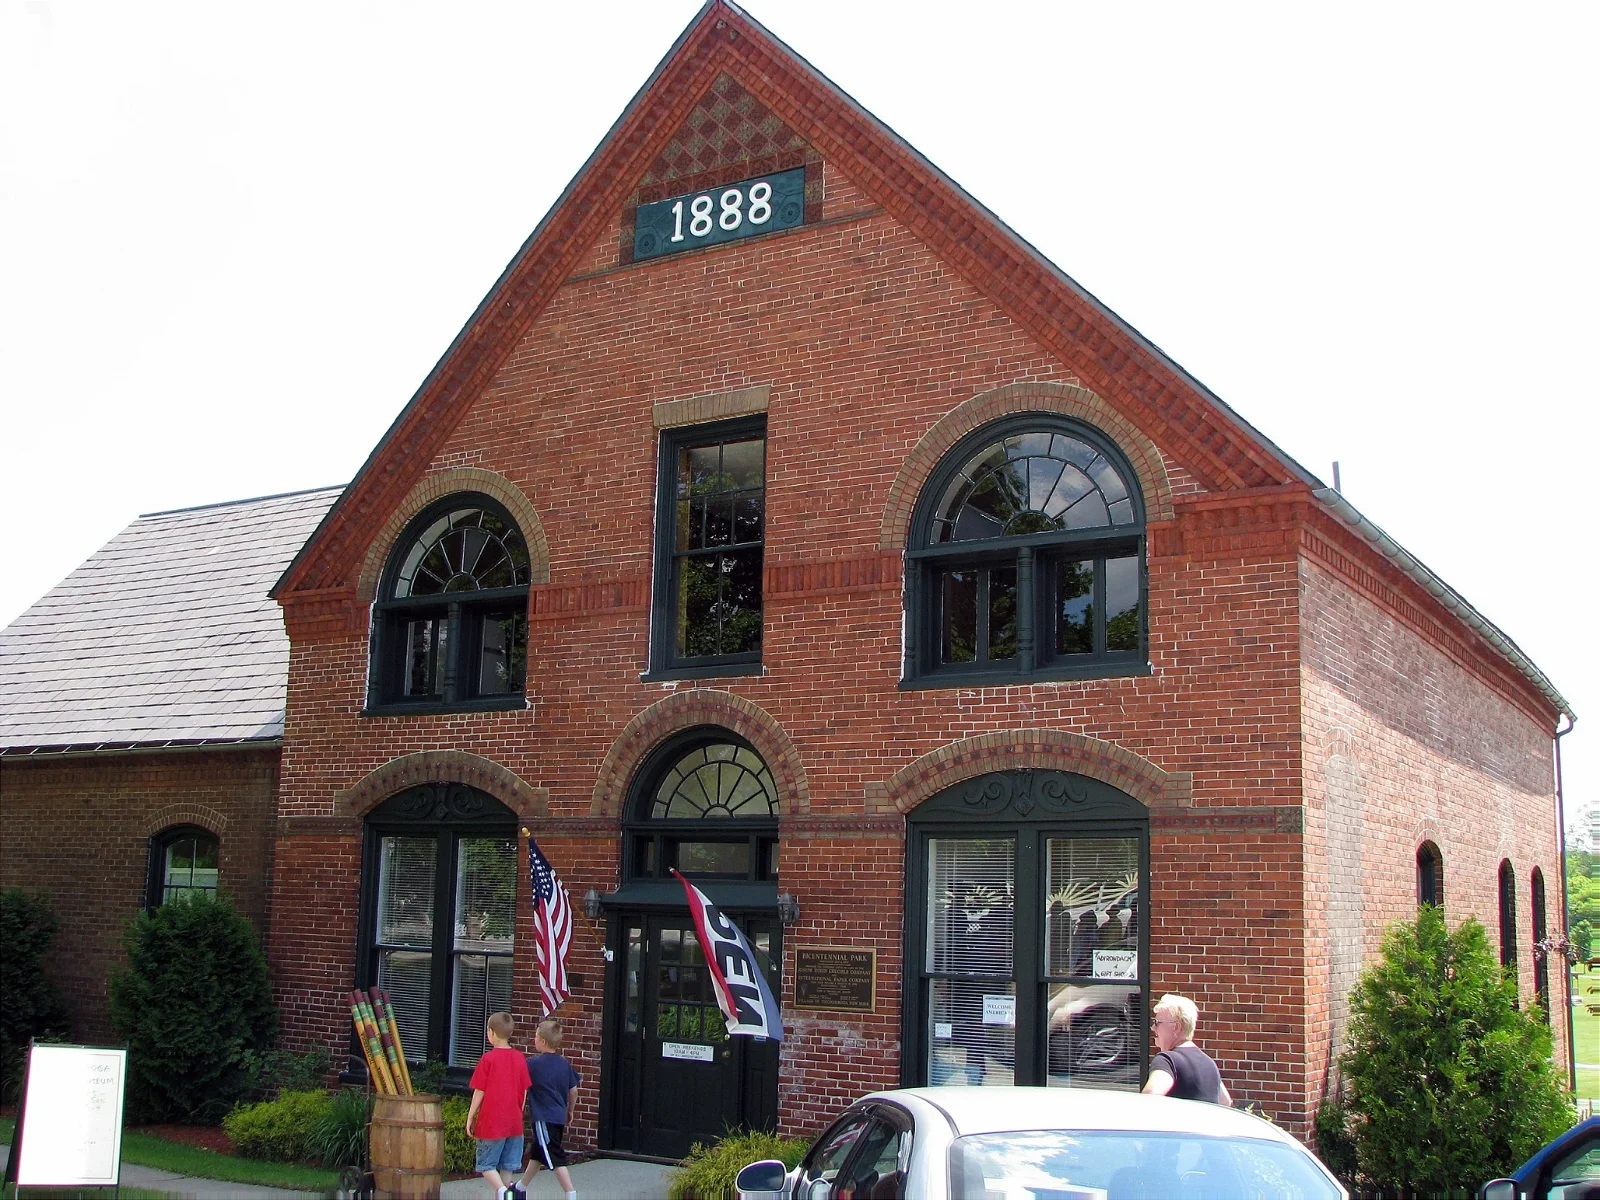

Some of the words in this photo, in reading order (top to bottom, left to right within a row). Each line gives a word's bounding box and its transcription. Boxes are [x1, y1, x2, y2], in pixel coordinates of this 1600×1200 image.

[671, 182, 772, 242] 1888
[705, 905, 763, 1026] PEN
[850, 954, 868, 962] PARK
